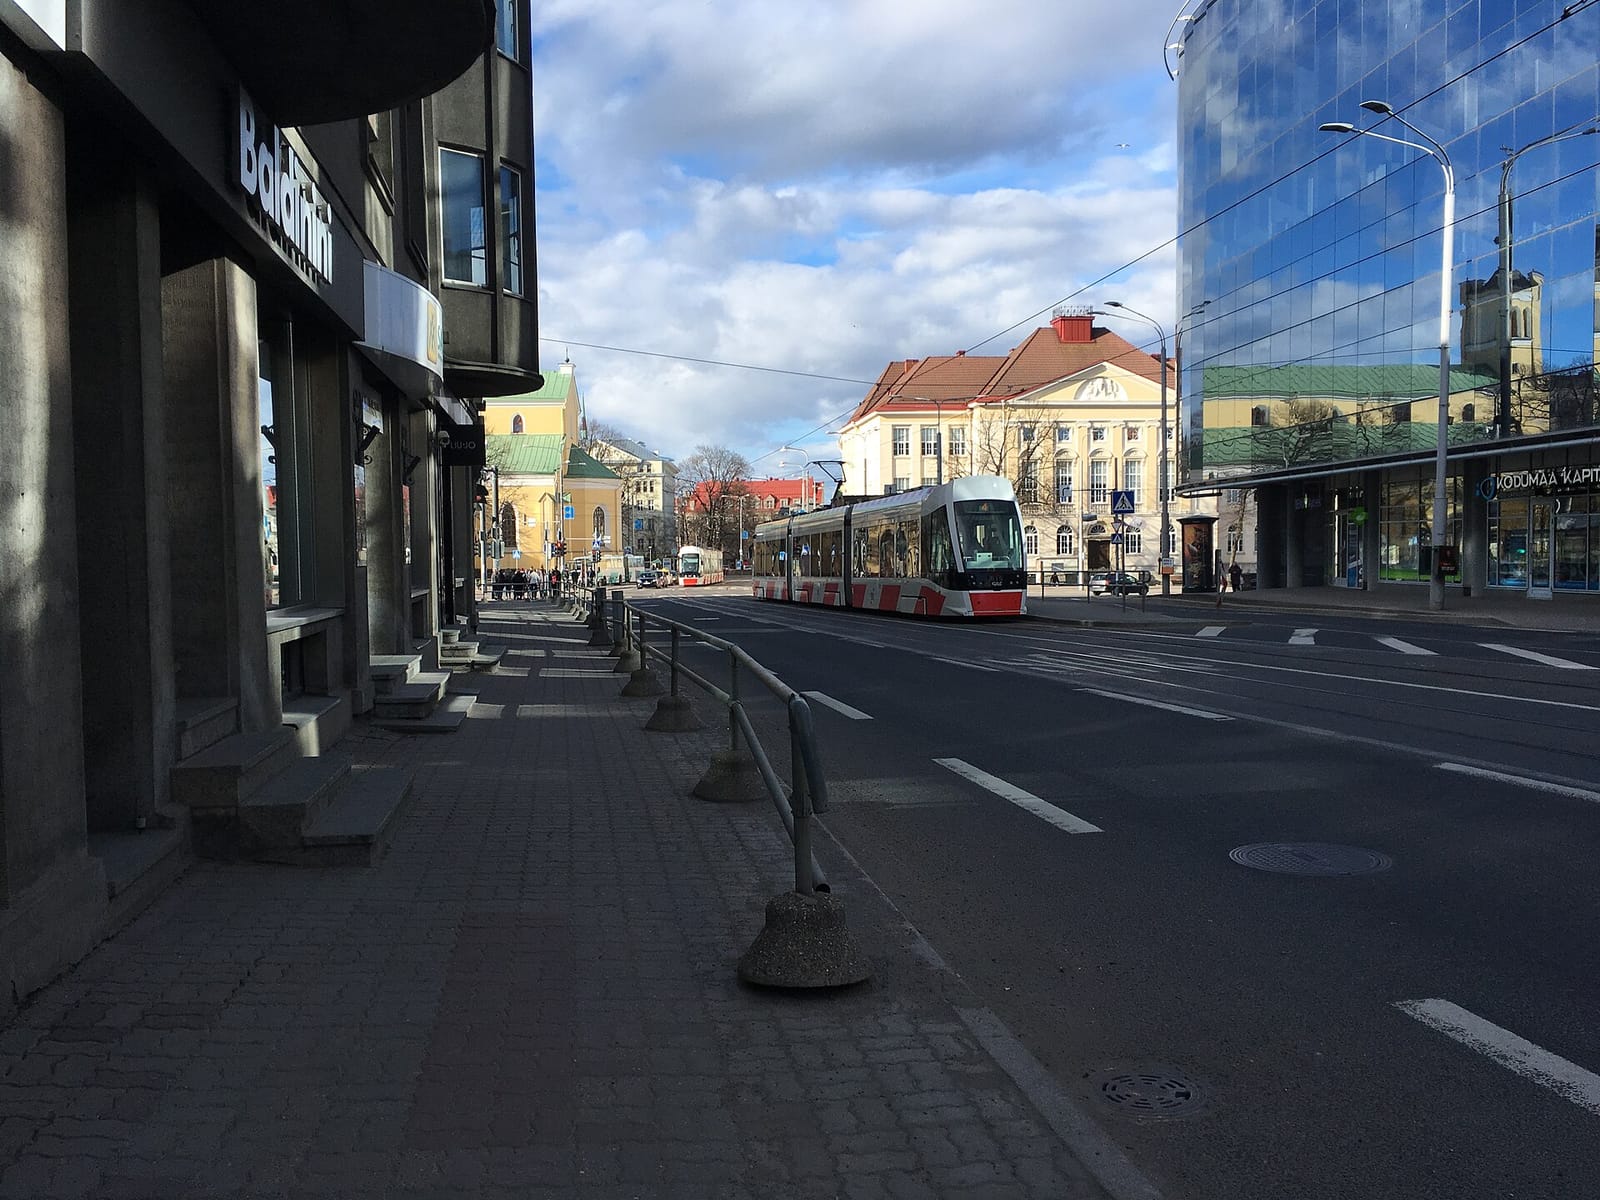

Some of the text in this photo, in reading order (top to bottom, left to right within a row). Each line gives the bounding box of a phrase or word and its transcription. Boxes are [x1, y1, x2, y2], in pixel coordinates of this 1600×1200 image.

[239, 84, 333, 285] Baldinini
[1496, 467, 1600, 489] KODUMAA KAPIT
